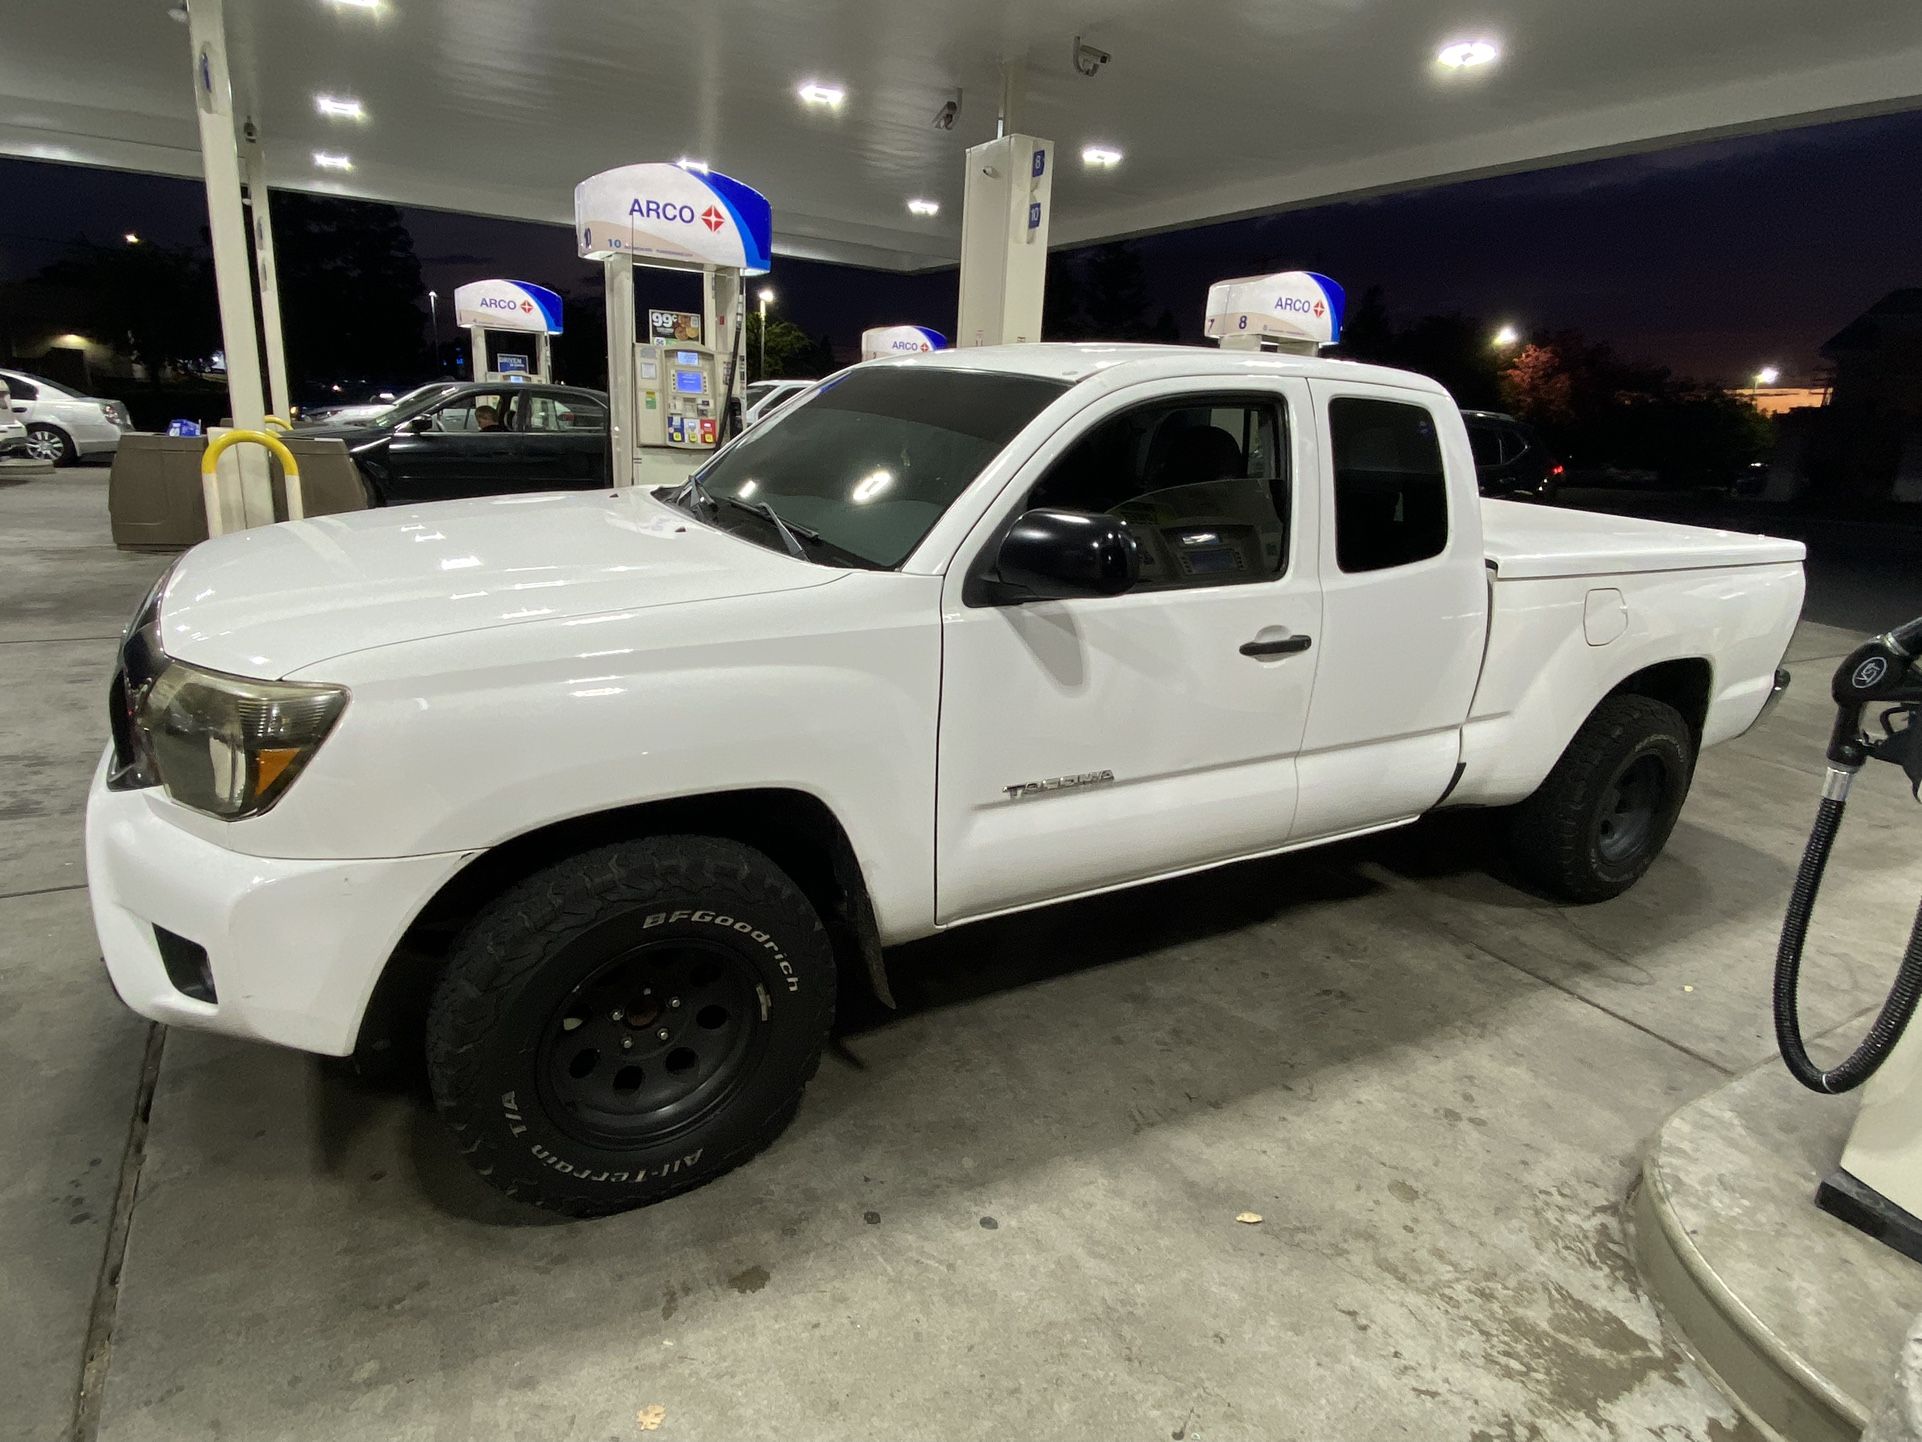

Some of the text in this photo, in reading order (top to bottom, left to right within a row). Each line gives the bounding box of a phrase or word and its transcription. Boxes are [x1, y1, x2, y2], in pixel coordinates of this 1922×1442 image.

[629, 198, 695, 224] ARCO
[1031, 207, 1039, 221] 10
[608, 239, 622, 248] 10
[480, 298, 517, 310] ARCO
[1274, 297, 1311, 313] ARCO
[1208, 318, 1215, 333] 7
[1238, 315, 1248, 330] 8
[891, 341, 918, 351] ARCO
[642, 910, 799, 992] BFGoodrich
